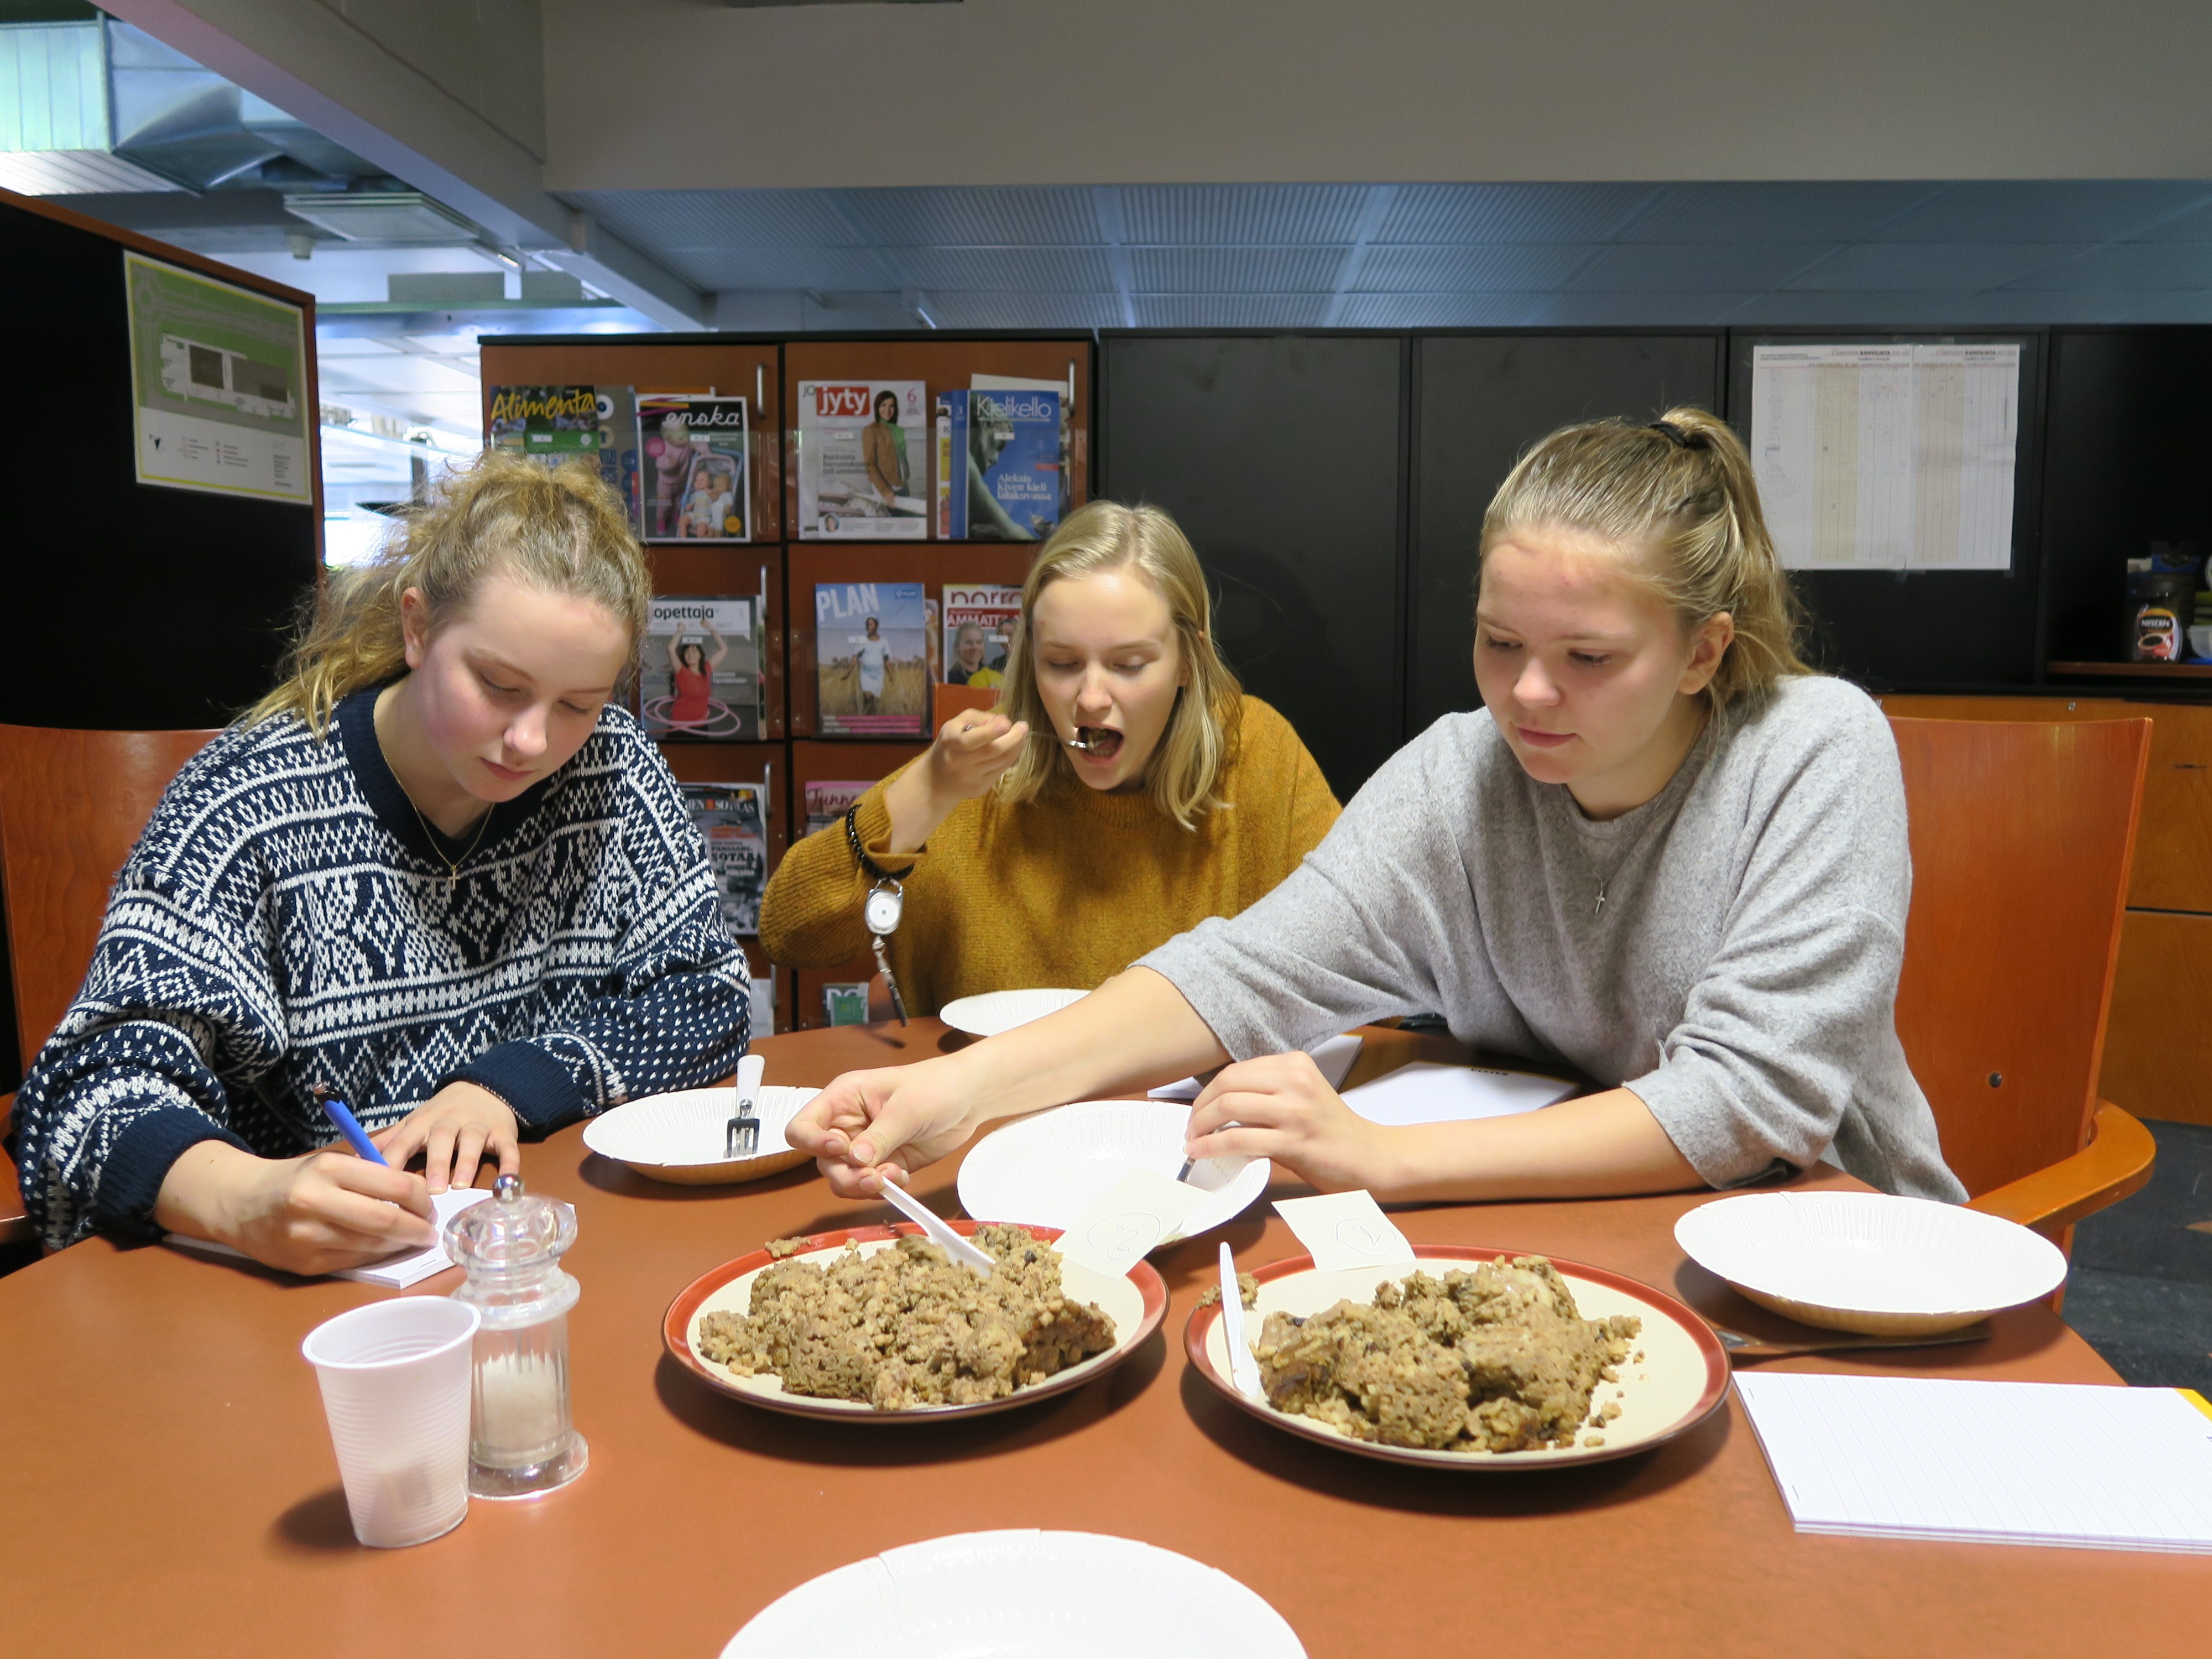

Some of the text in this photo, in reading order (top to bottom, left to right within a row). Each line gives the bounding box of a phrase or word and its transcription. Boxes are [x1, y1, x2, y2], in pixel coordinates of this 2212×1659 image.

[491, 389, 596, 424] Alimenta
[820, 385, 867, 415] jyty
[907, 389, 917, 403] 6
[665, 405, 740, 426] enska
[654, 606, 714, 620] opettaja
[816, 583, 879, 622] PLAN
